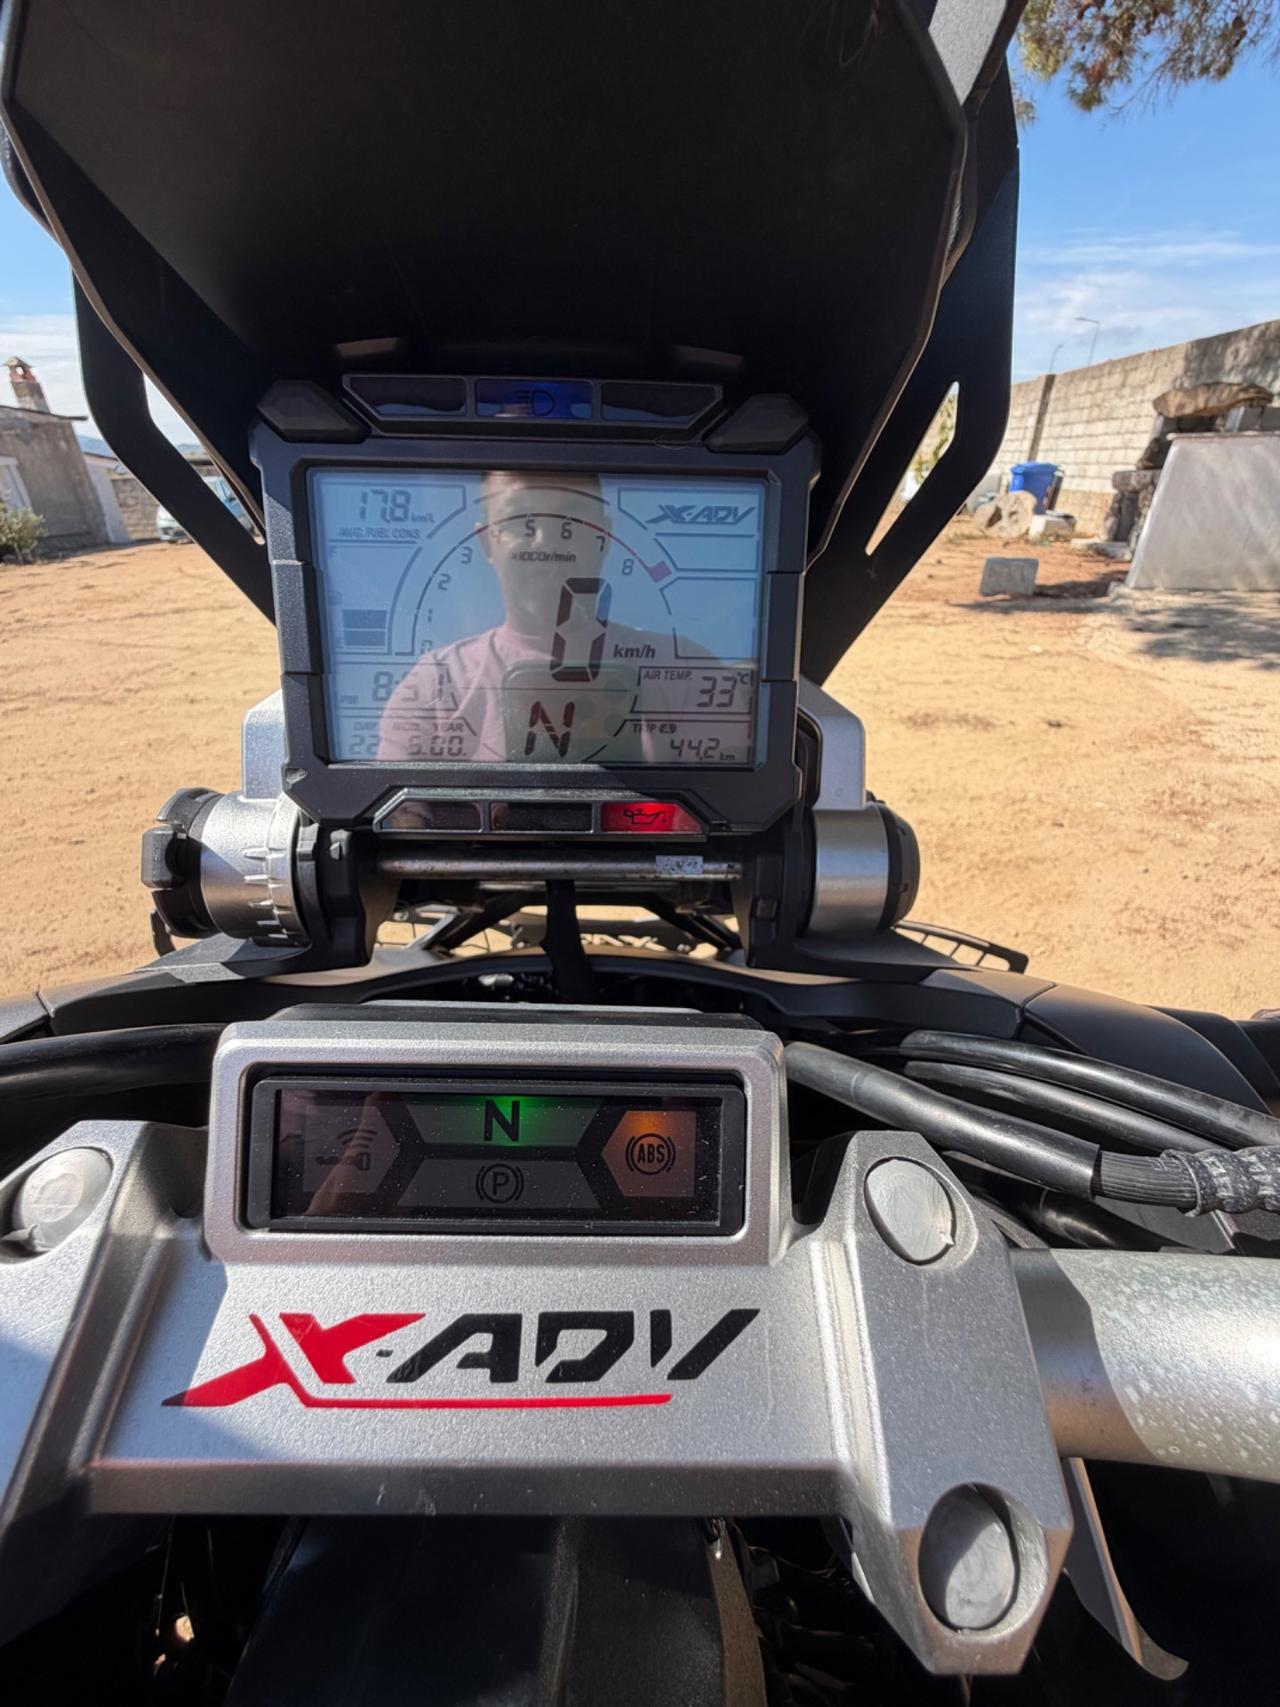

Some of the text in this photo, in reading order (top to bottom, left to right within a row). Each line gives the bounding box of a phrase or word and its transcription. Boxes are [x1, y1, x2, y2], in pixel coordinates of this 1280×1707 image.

[645, 504, 755, 525] X-ADV
[525, 519, 536, 538] 5
[561, 522, 572, 540] 6
[595, 535, 605, 552] 7
[460, 546, 473, 564] 3
[622, 558, 634, 576] 8
[438, 573, 451, 591] 2
[550, 577, 656, 682] 0 km/h
[643, 670, 661, 680] AIR
[696, 675, 738, 708] 33
[433, 722, 464, 732] YEAR
[524, 700, 576, 758] N
[670, 738, 720, 761] 44.2
[483, 1101, 521, 1142] N
[636, 1142, 667, 1164] ABS
[492, 1171, 509, 1196] P
[162, 1308, 758, 1408] X-ADV
